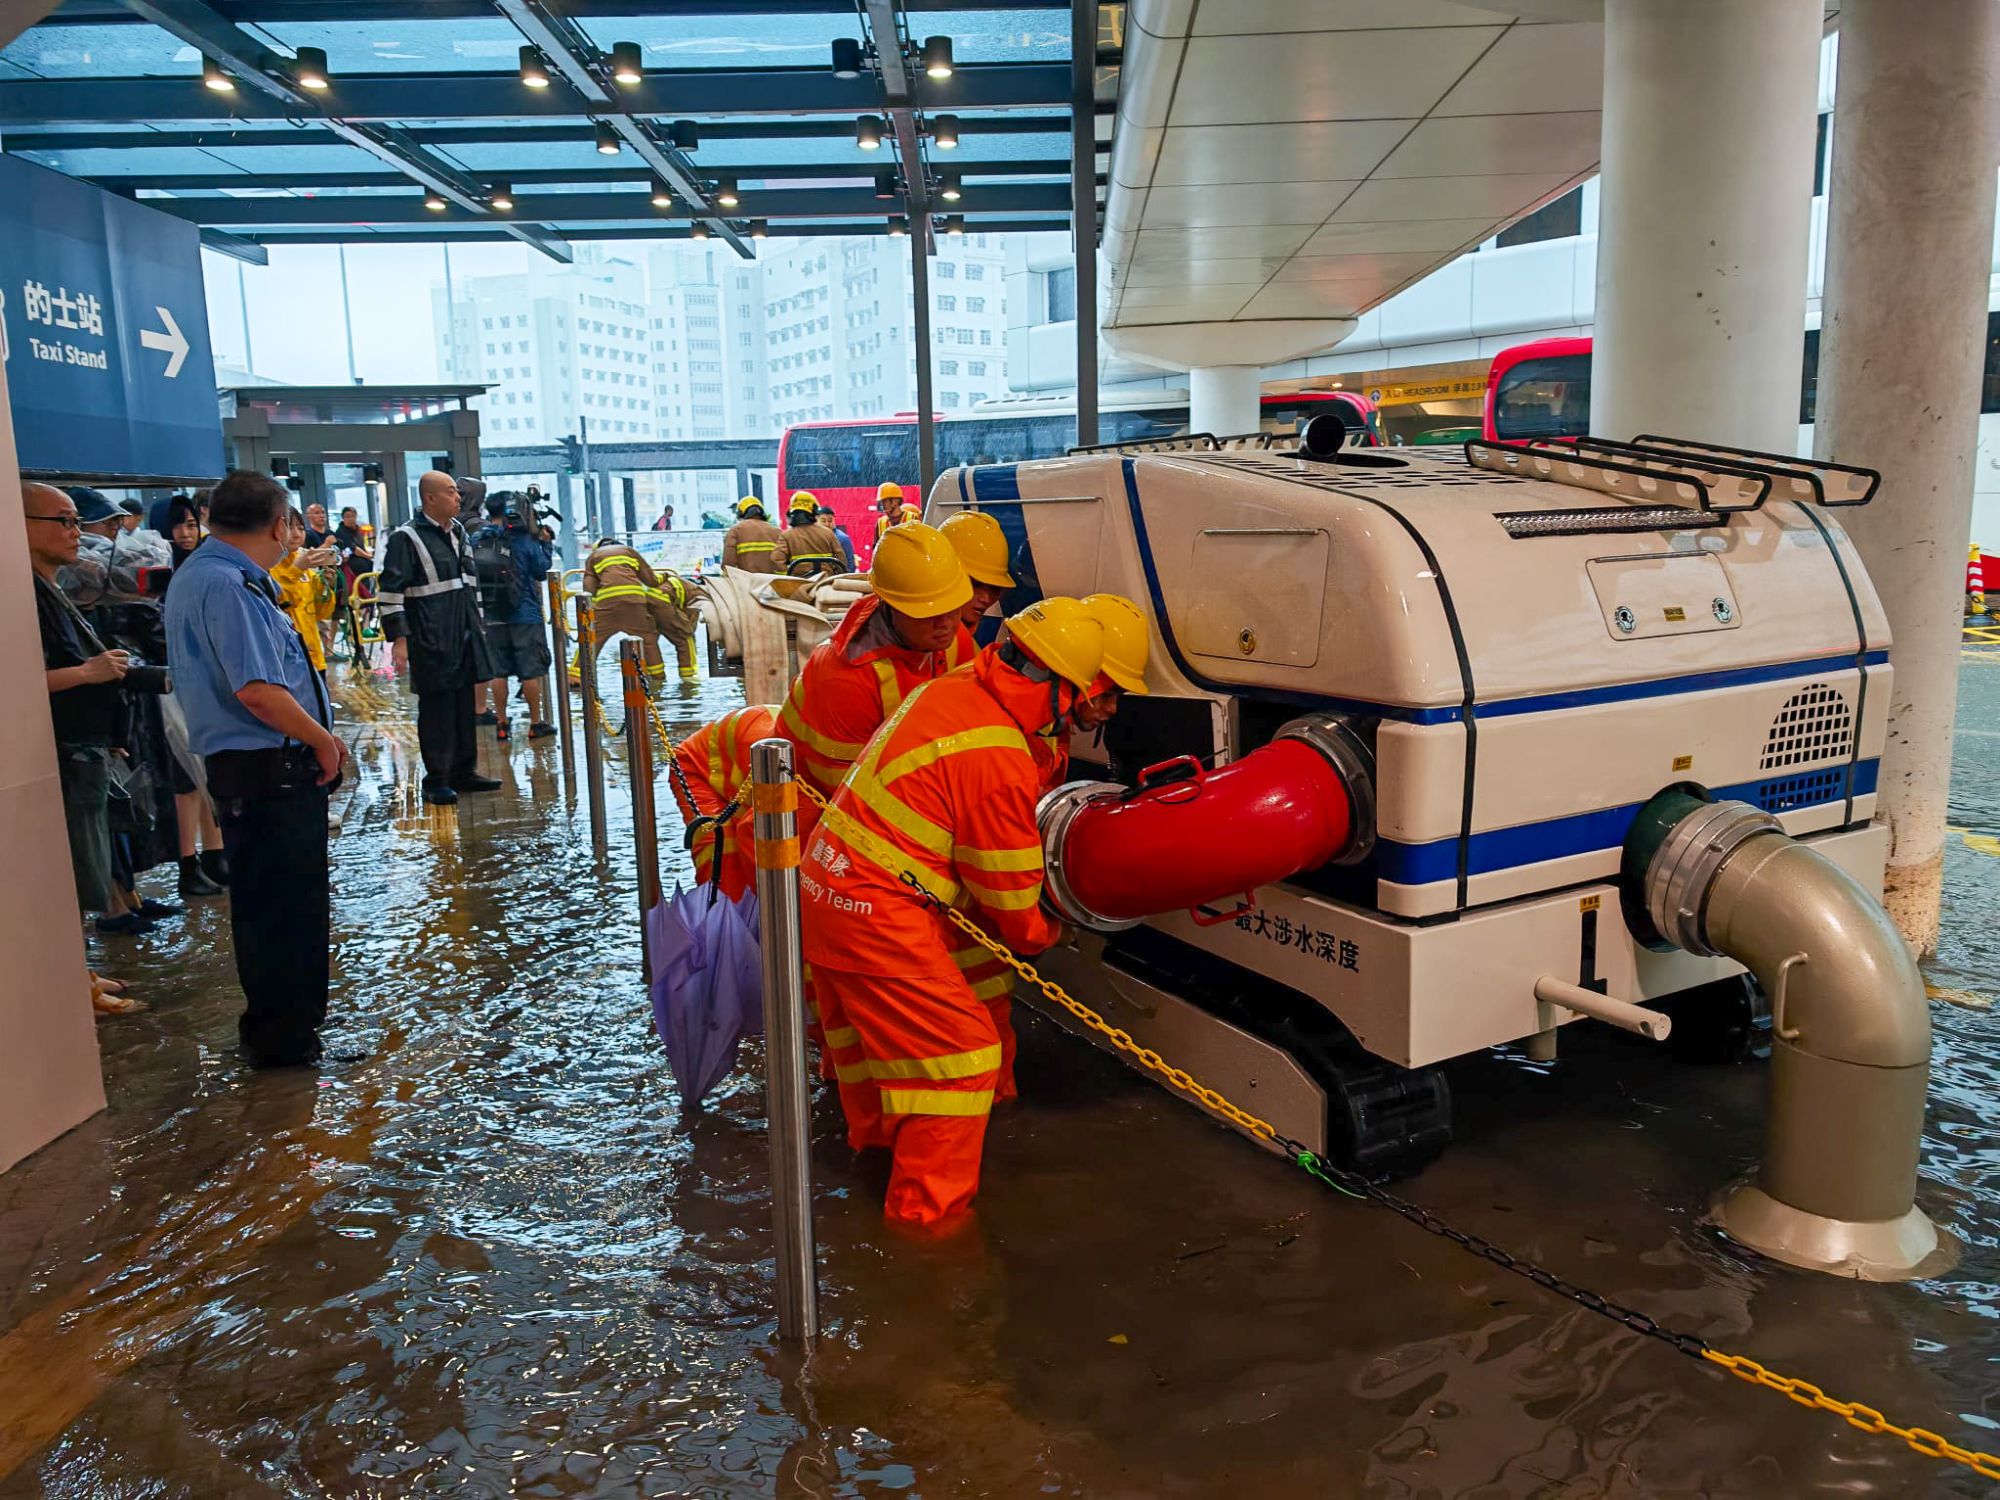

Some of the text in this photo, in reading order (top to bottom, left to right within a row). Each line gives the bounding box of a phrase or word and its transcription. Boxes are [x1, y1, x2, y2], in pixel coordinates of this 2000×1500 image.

[23, 279, 104, 337] 的士站
[29, 338, 108, 370] Taxi Stand
[1403, 385, 1449, 397] HEADROOM
[827, 887, 873, 915] Team
